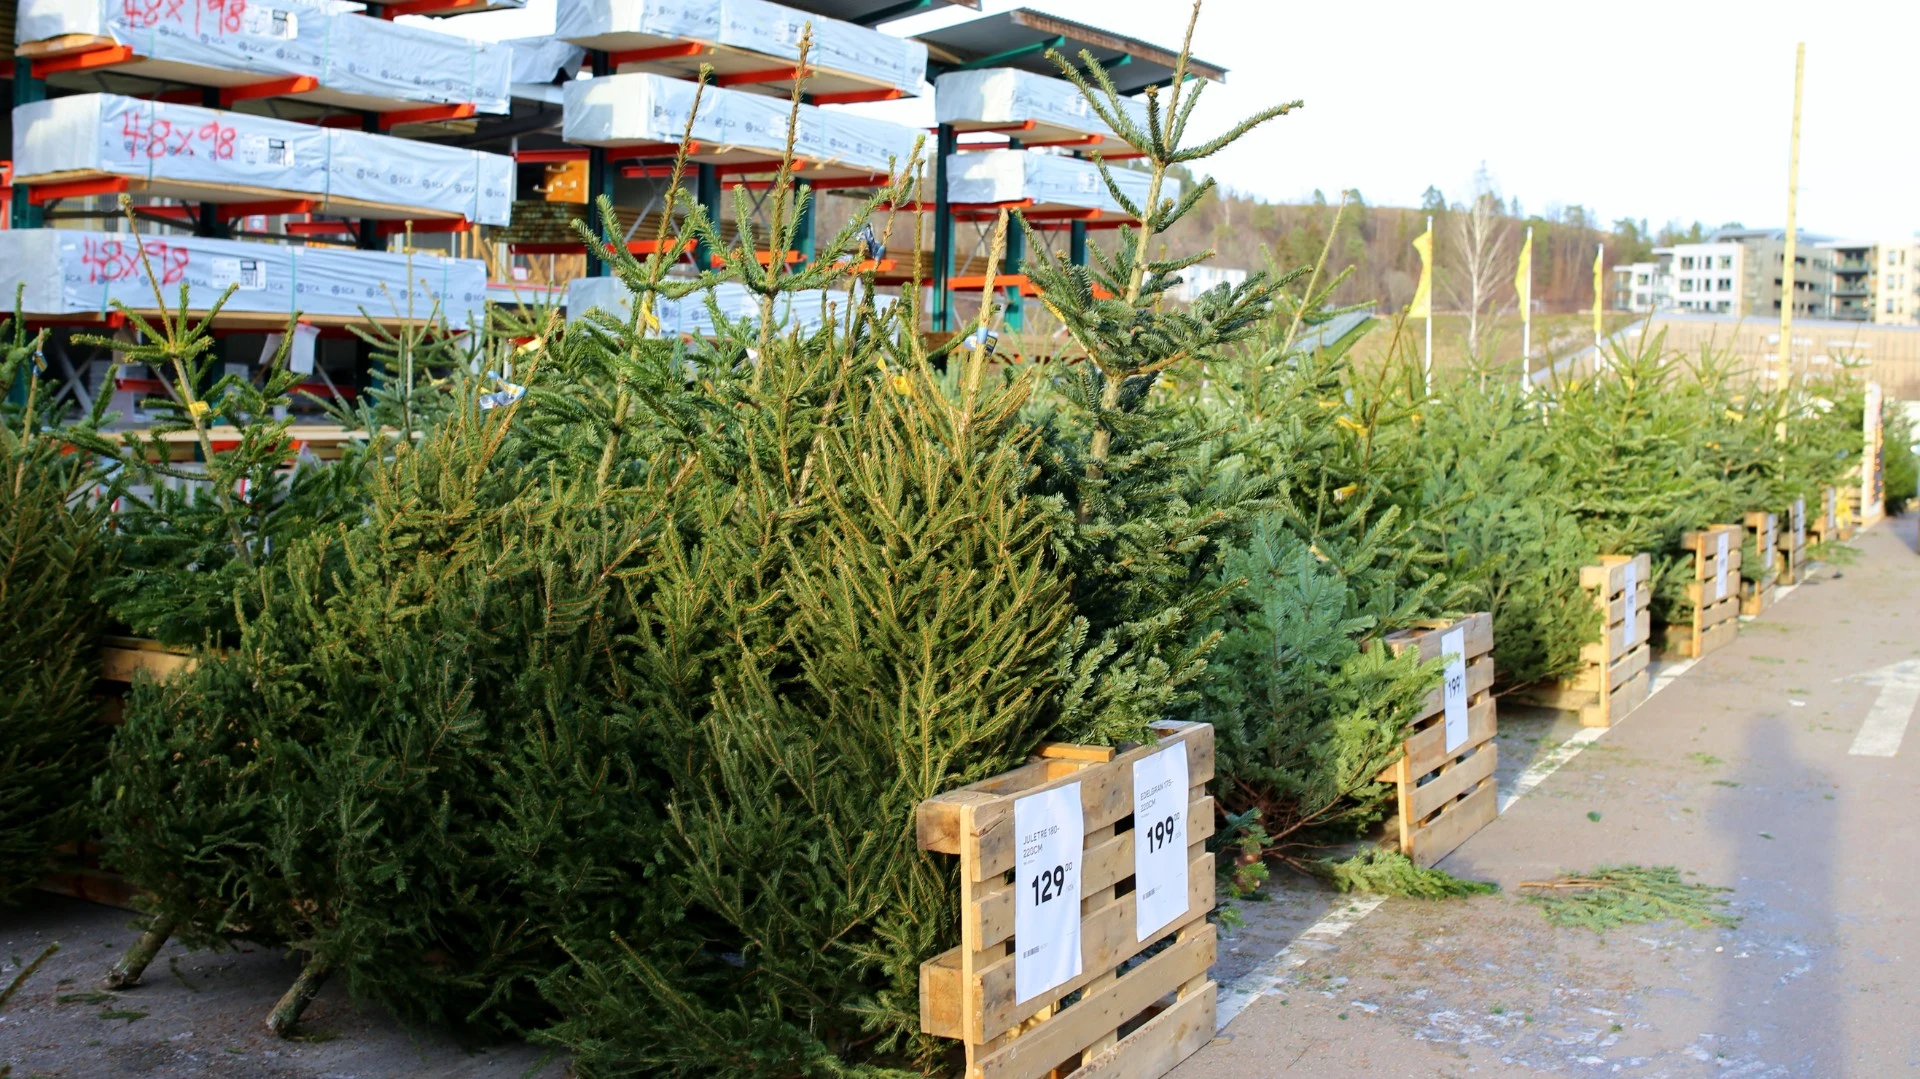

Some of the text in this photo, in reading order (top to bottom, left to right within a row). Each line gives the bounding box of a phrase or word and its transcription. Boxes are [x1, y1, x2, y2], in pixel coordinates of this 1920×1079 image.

[1448, 675, 1460, 698] 199
[1140, 782, 1163, 801] EDELGRAN
[1140, 798, 1156, 813] 220CM
[1023, 828, 1047, 845] JULETRE
[1147, 815, 1174, 854] 199
[1023, 843, 1043, 858] 220CM
[1032, 865, 1065, 906] 129
[1065, 861, 1073, 872] 00
